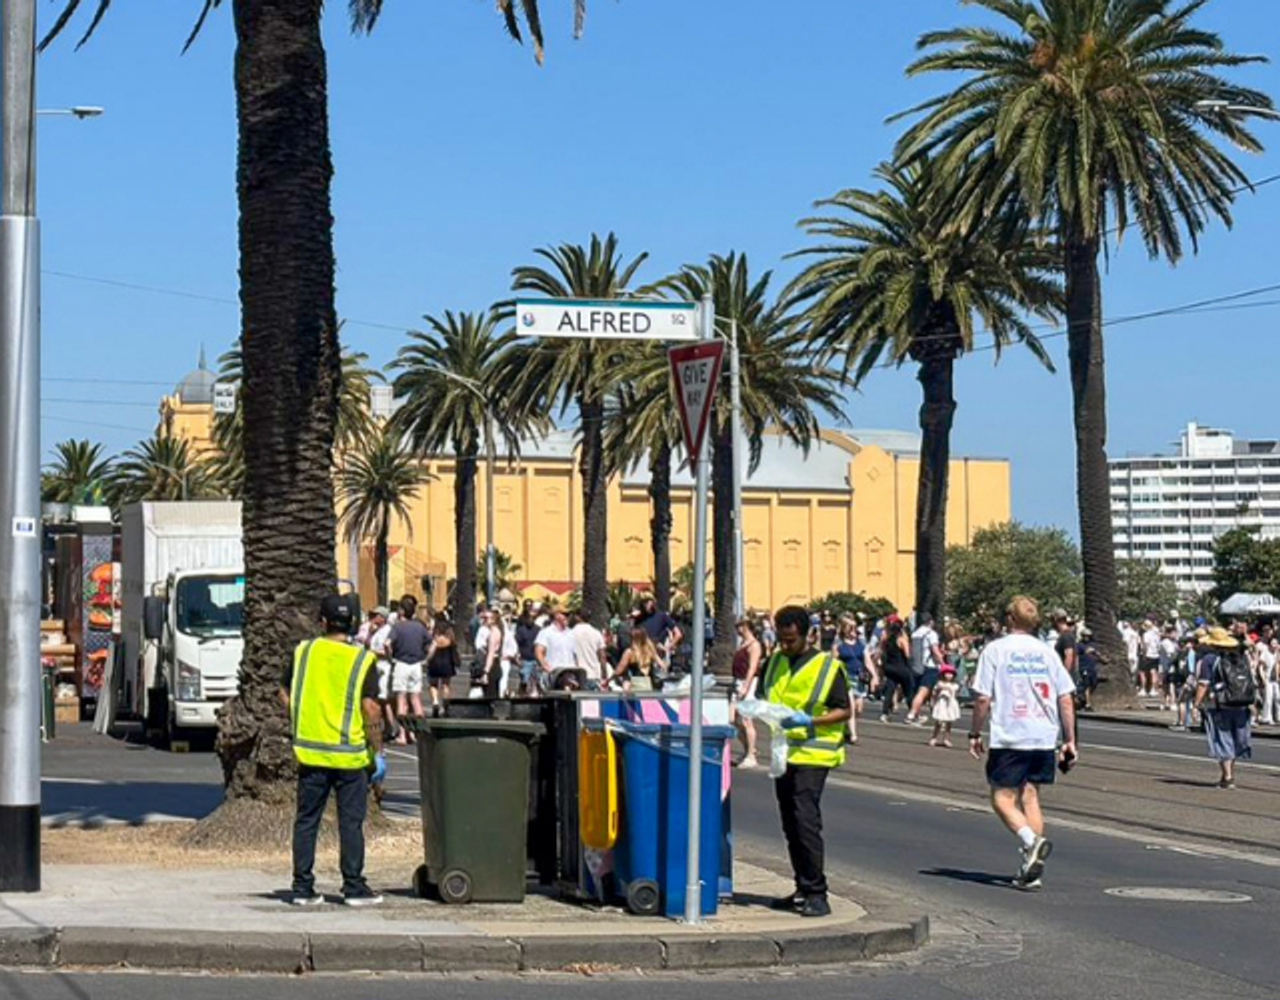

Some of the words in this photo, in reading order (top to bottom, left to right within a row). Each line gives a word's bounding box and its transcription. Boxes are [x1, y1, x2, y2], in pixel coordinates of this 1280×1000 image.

[557, 311, 652, 333] ALFRED
[671, 313, 686, 325] SQ
[683, 363, 707, 385] GIVE
